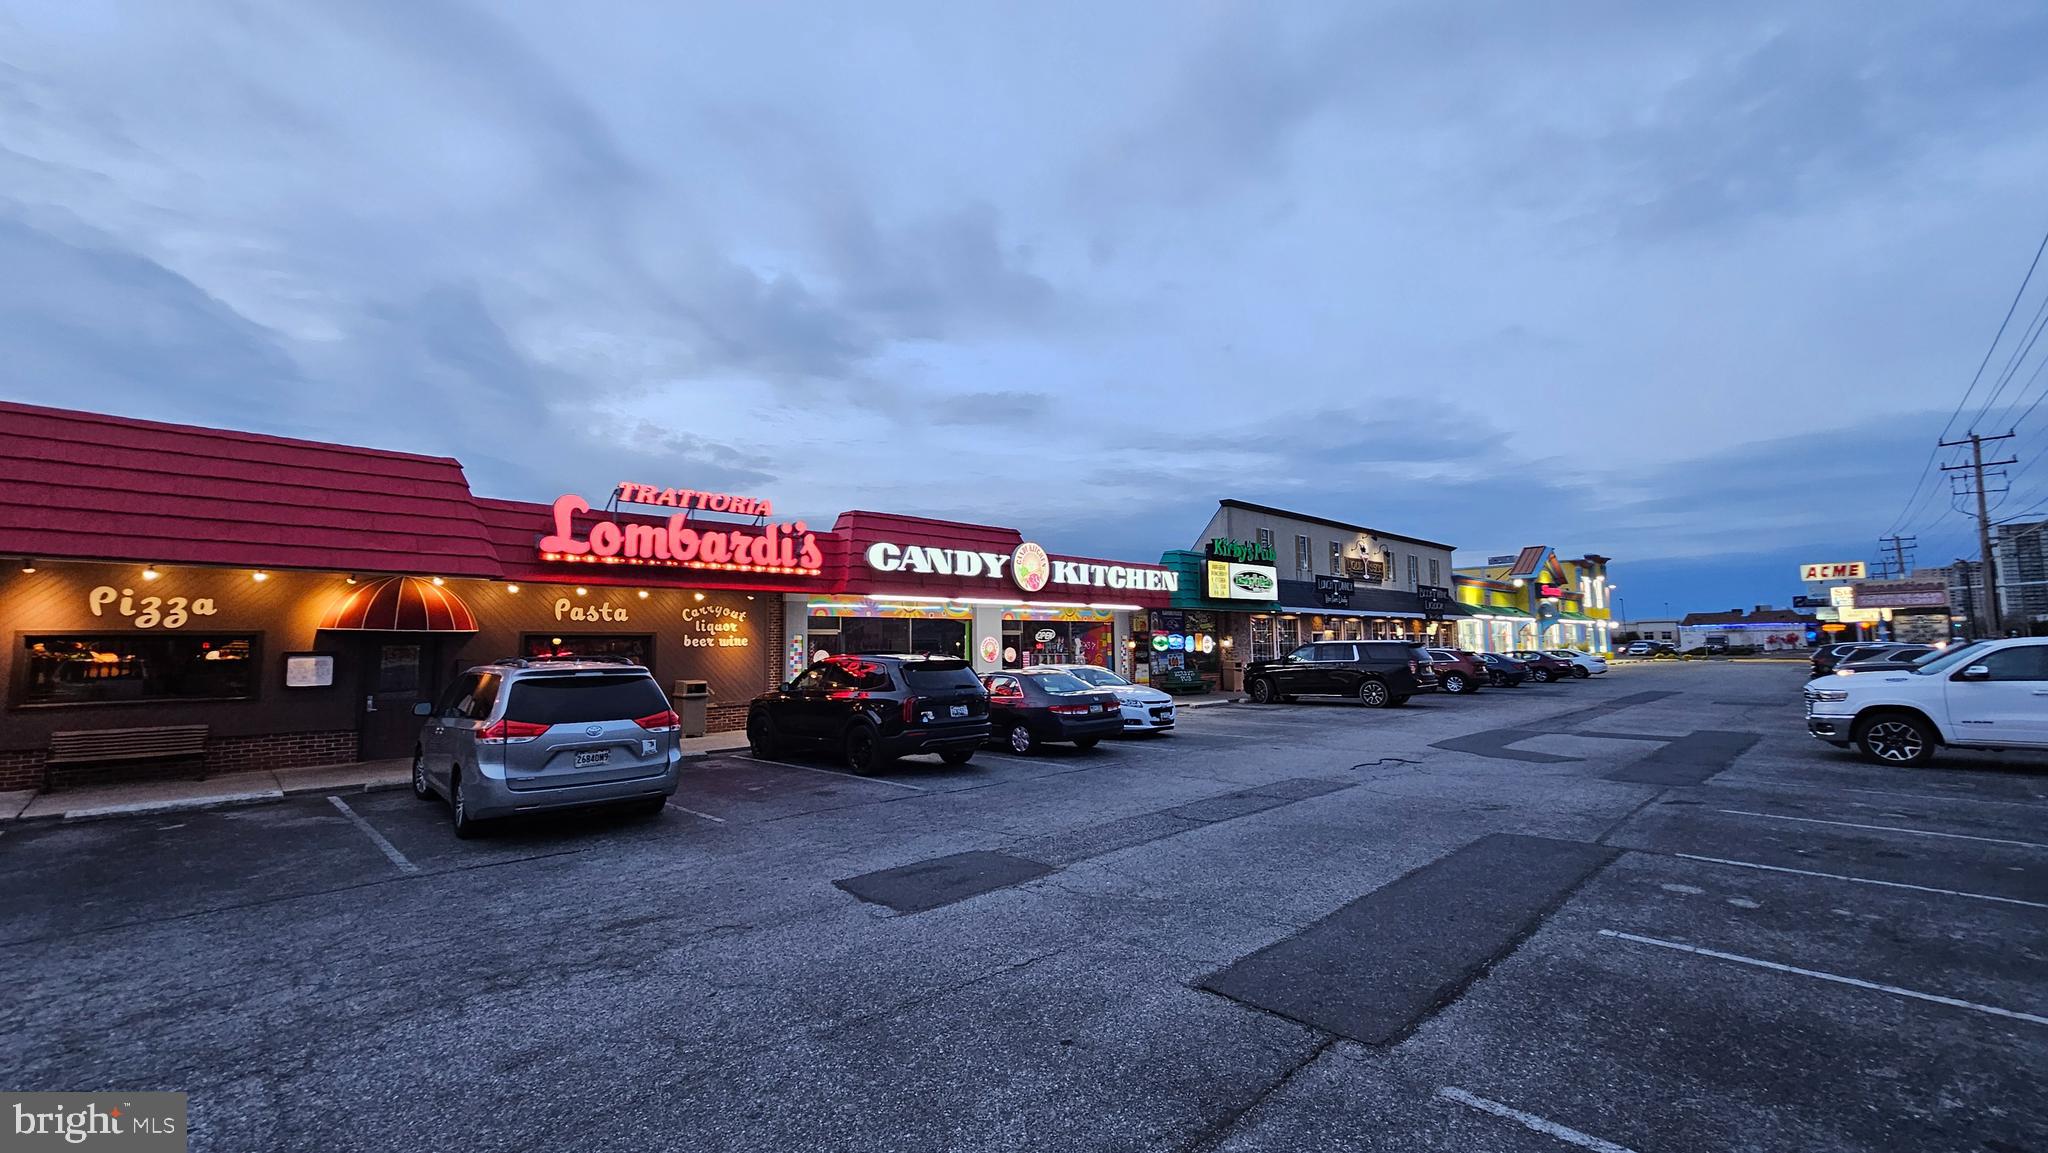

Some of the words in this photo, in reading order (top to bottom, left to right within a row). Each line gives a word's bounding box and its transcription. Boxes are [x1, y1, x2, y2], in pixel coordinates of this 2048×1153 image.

[618, 481, 773, 517] TRATTORIA
[539, 494, 823, 569] Lombardi's
[1212, 537, 1254, 562] Kirby's
[1253, 543, 1277, 561] Pub
[867, 542, 1011, 579] CANDY
[1053, 560, 1179, 592] KITCHEN
[1806, 564, 1859, 579] ACME
[89, 586, 217, 628] Pizza
[555, 598, 629, 622] Pasta
[682, 605, 747, 622] Carryout
[695, 619, 738, 635] liquor
[683, 634, 715, 647] beer
[718, 635, 749, 647] wine
